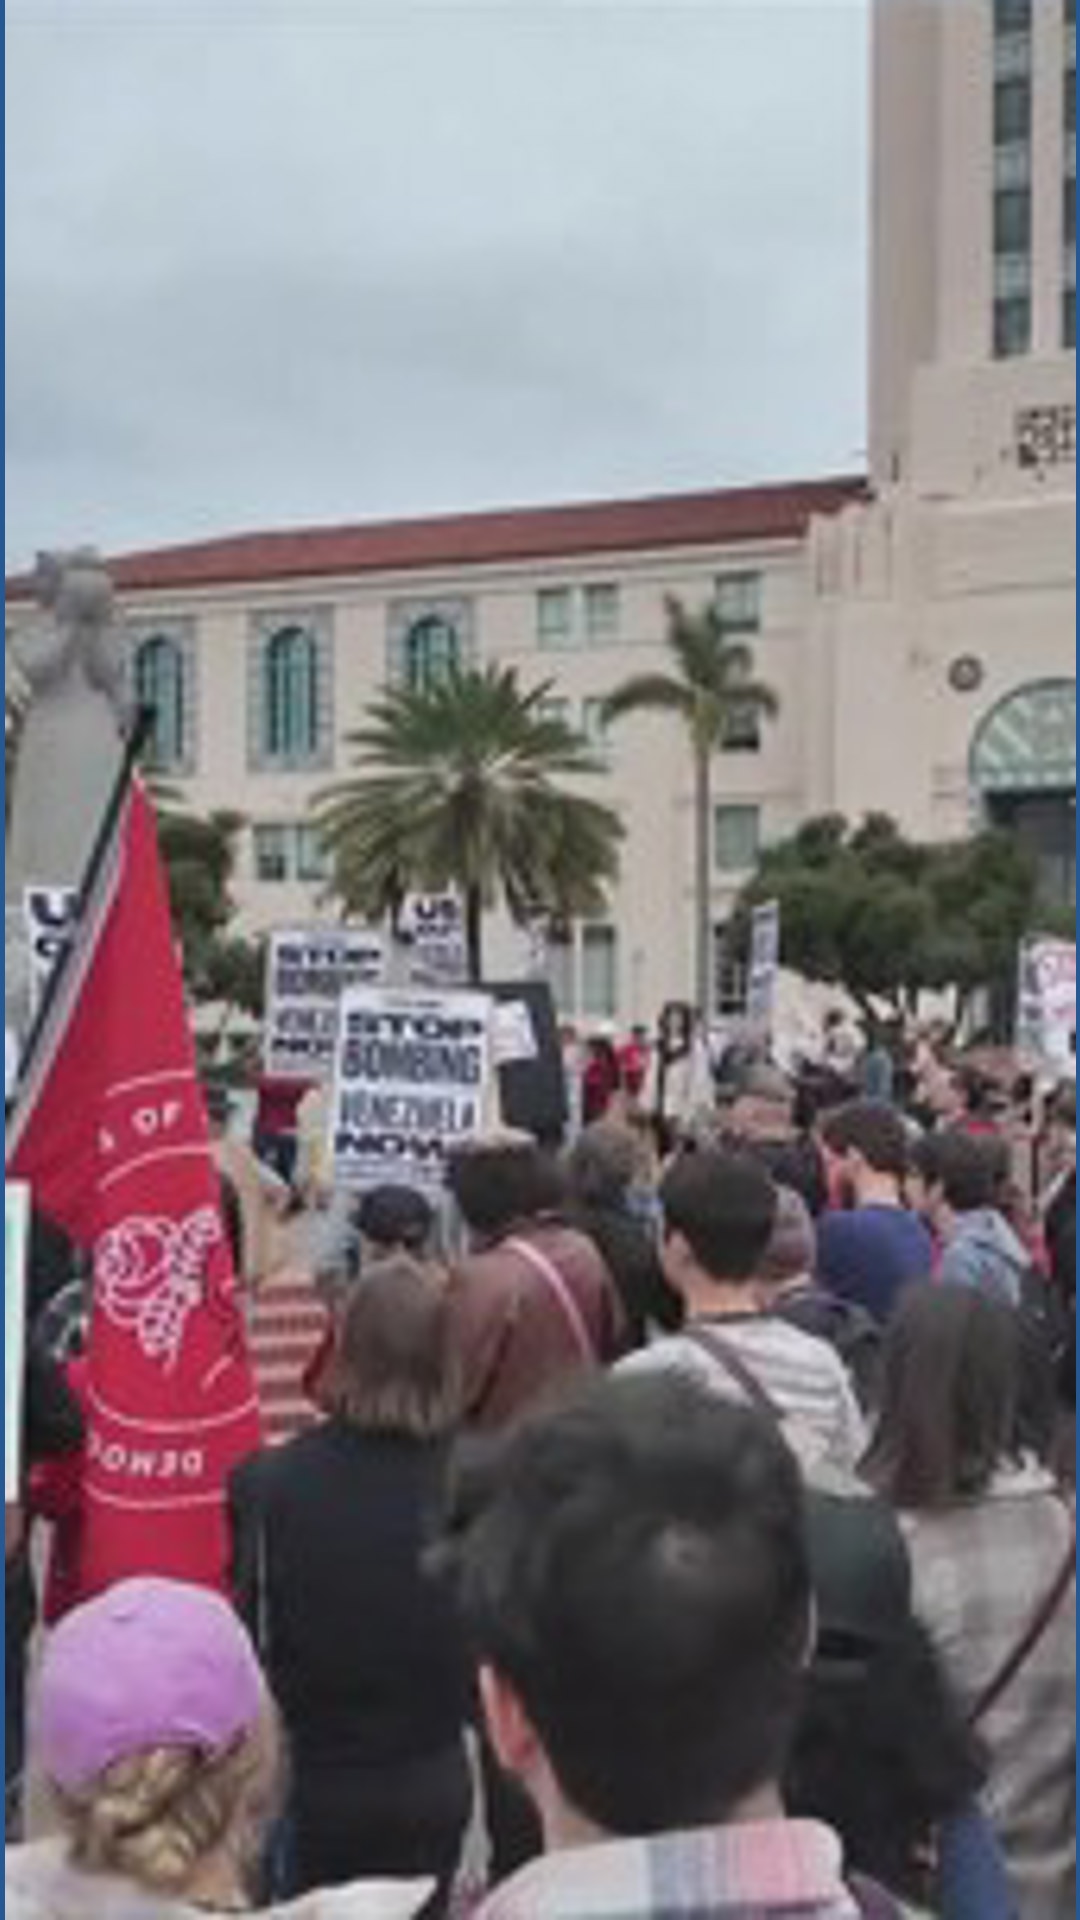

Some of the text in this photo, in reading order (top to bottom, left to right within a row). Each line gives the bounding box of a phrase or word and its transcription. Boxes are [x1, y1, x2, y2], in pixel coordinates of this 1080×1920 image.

[277, 945, 381, 963] STOP
[346, 1012, 482, 1039] STOP
[342, 1038, 480, 1085] BOMBING
[132, 1101, 181, 1137] OF
[341, 1091, 475, 1134] VENEZUELA
